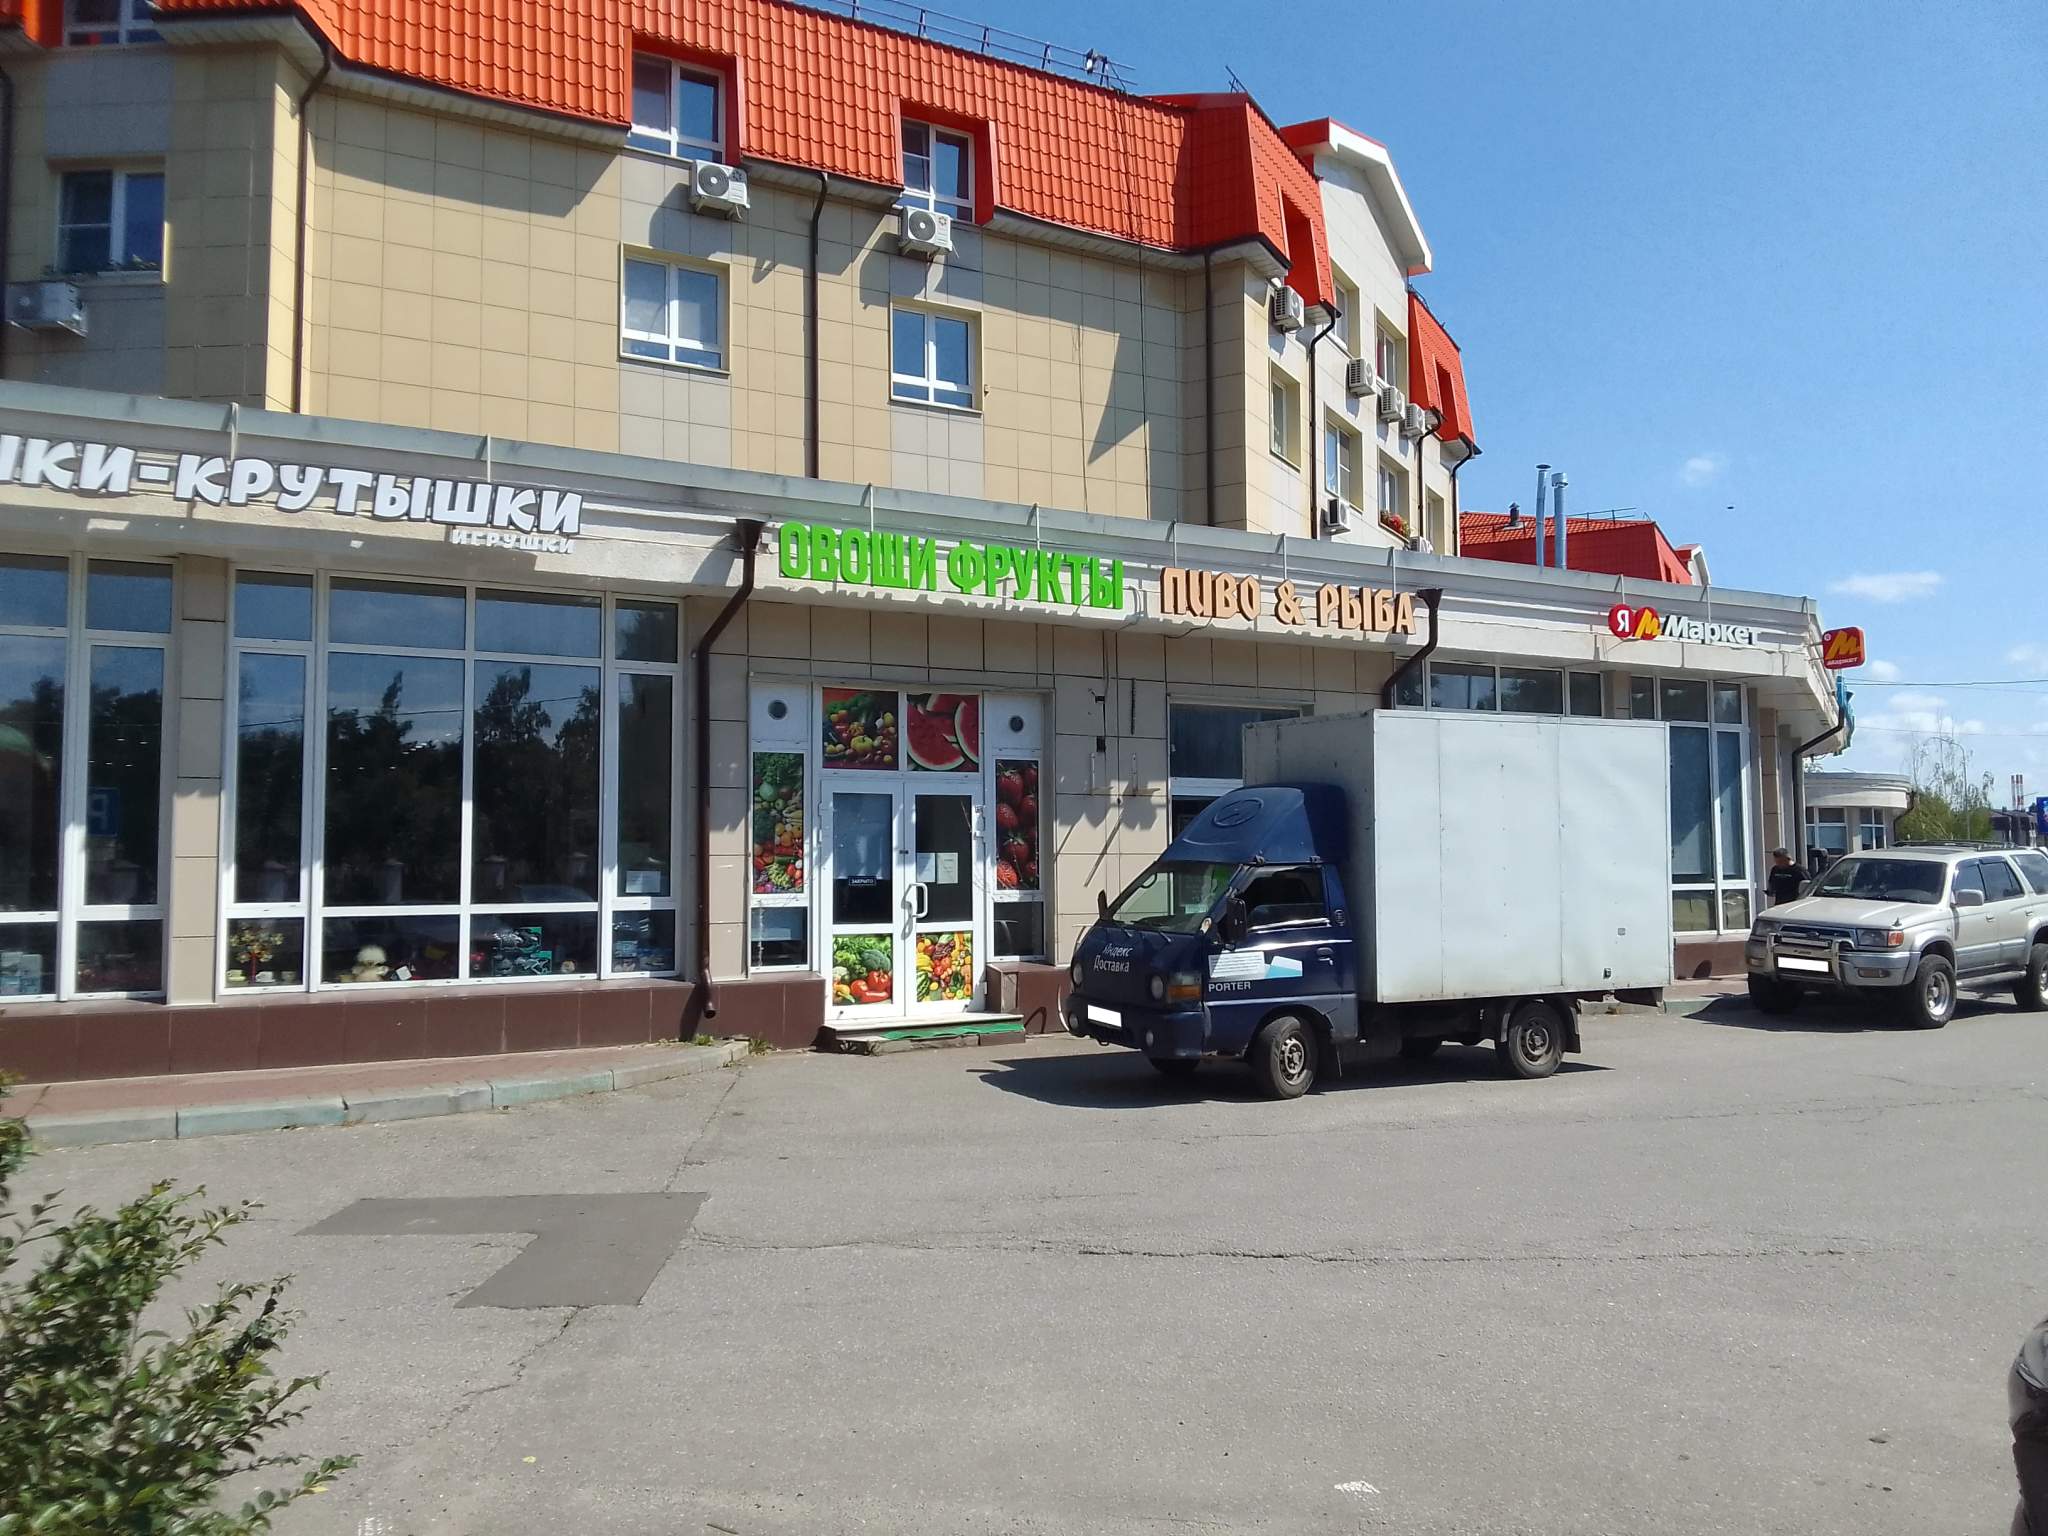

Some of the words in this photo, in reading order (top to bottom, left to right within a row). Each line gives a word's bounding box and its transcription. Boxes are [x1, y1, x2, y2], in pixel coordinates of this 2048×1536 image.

[452, 529, 575, 554] ИГРУШКИ
[779, 521, 937, 591] ОВОЩИ
[947, 539, 1124, 609] ФРУКТЫ
[1160, 567, 1261, 621] ПИВО
[1275, 579, 1306, 625] &
[1316, 583, 1416, 634] РЫБА
[1663, 614, 1762, 645] Маркет
[1093, 954, 1130, 973] Доставка
[1208, 981, 1251, 993] PORTER
